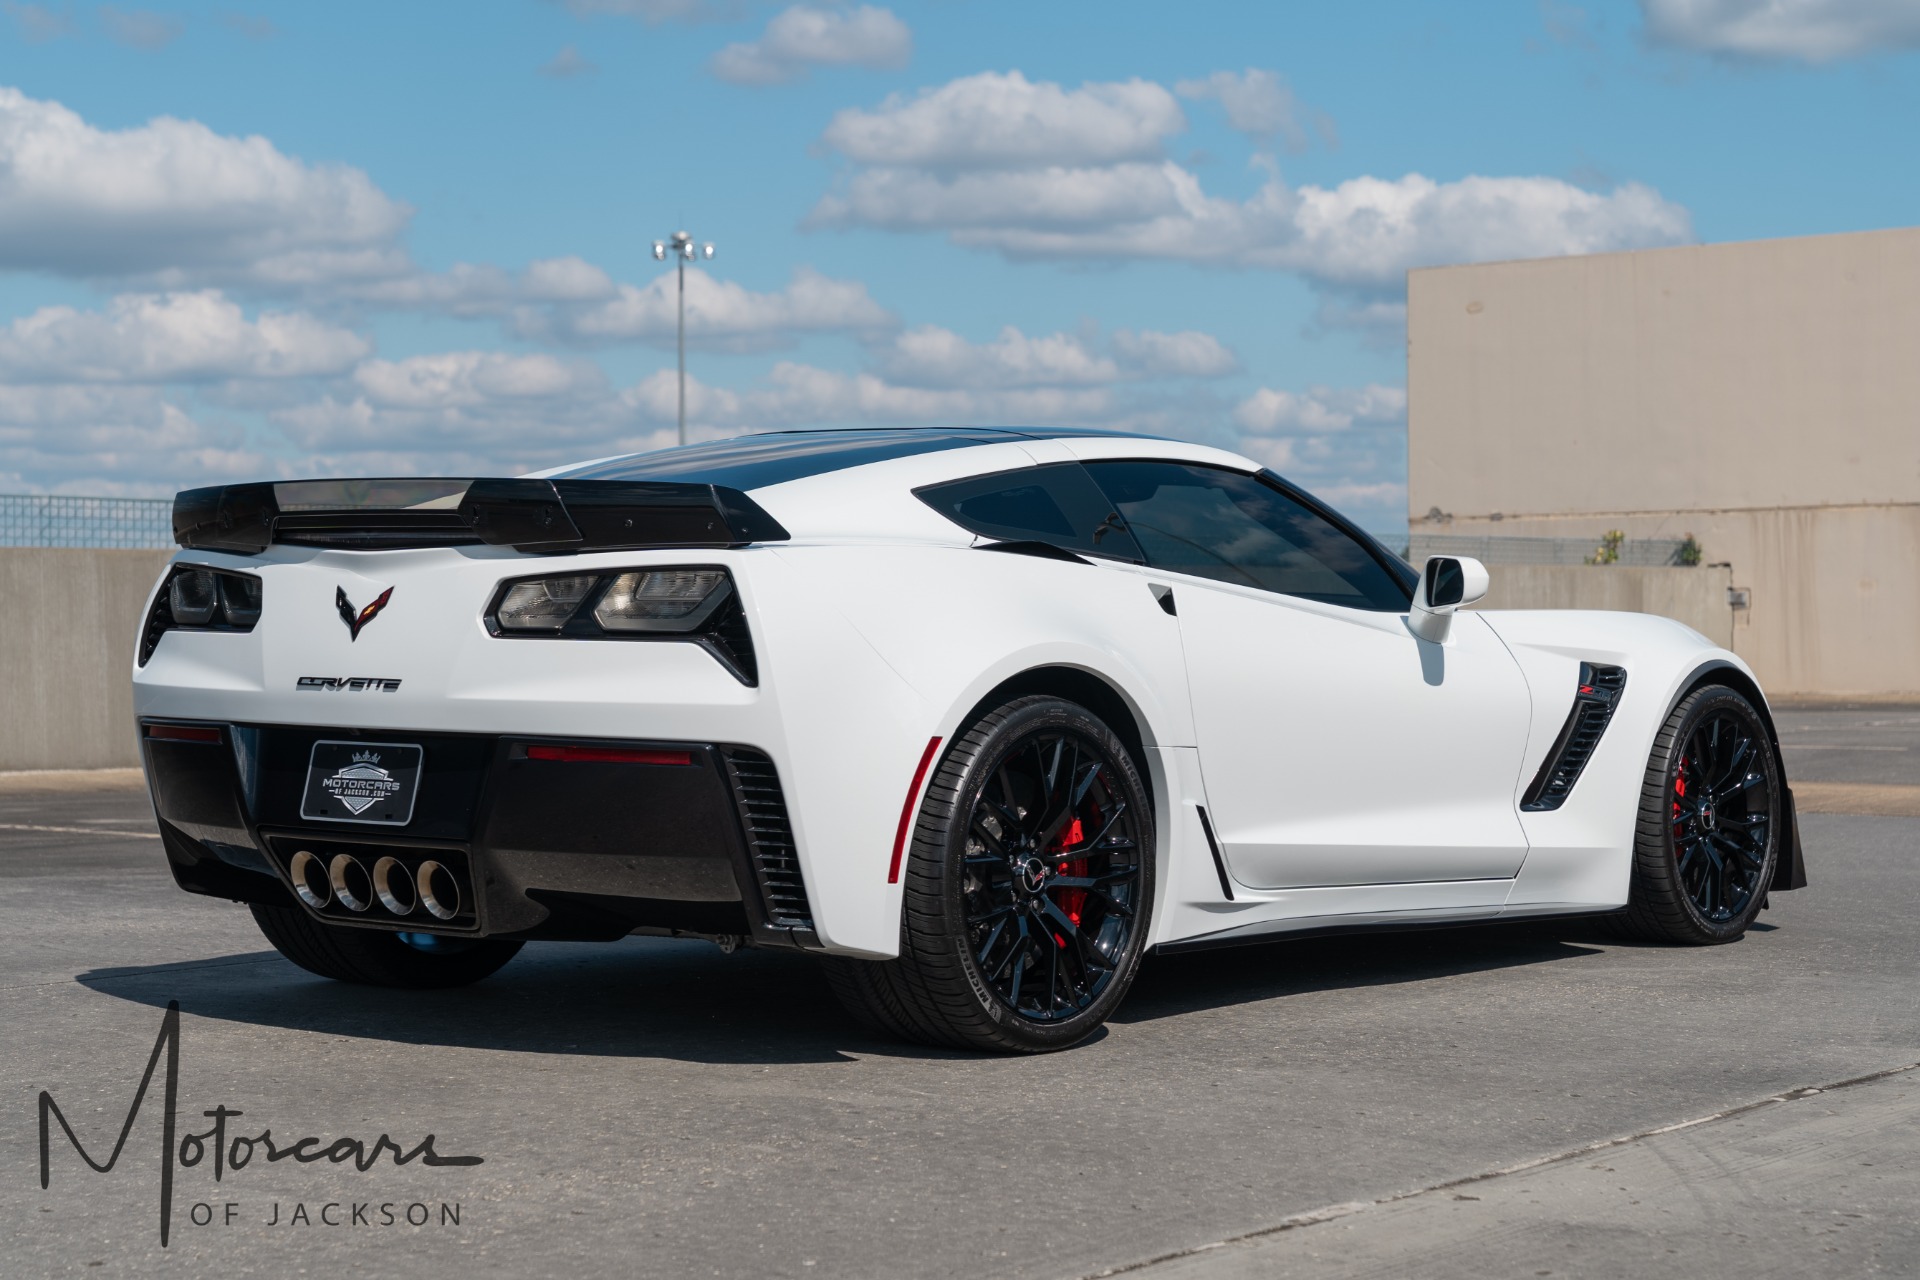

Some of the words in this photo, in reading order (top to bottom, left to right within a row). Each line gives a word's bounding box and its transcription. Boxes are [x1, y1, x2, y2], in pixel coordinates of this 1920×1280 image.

[296, 677, 403, 690] CORVETTE
[322, 778, 401, 792] MOTORCARS
[957, 937, 990, 1004] MICHELIN
